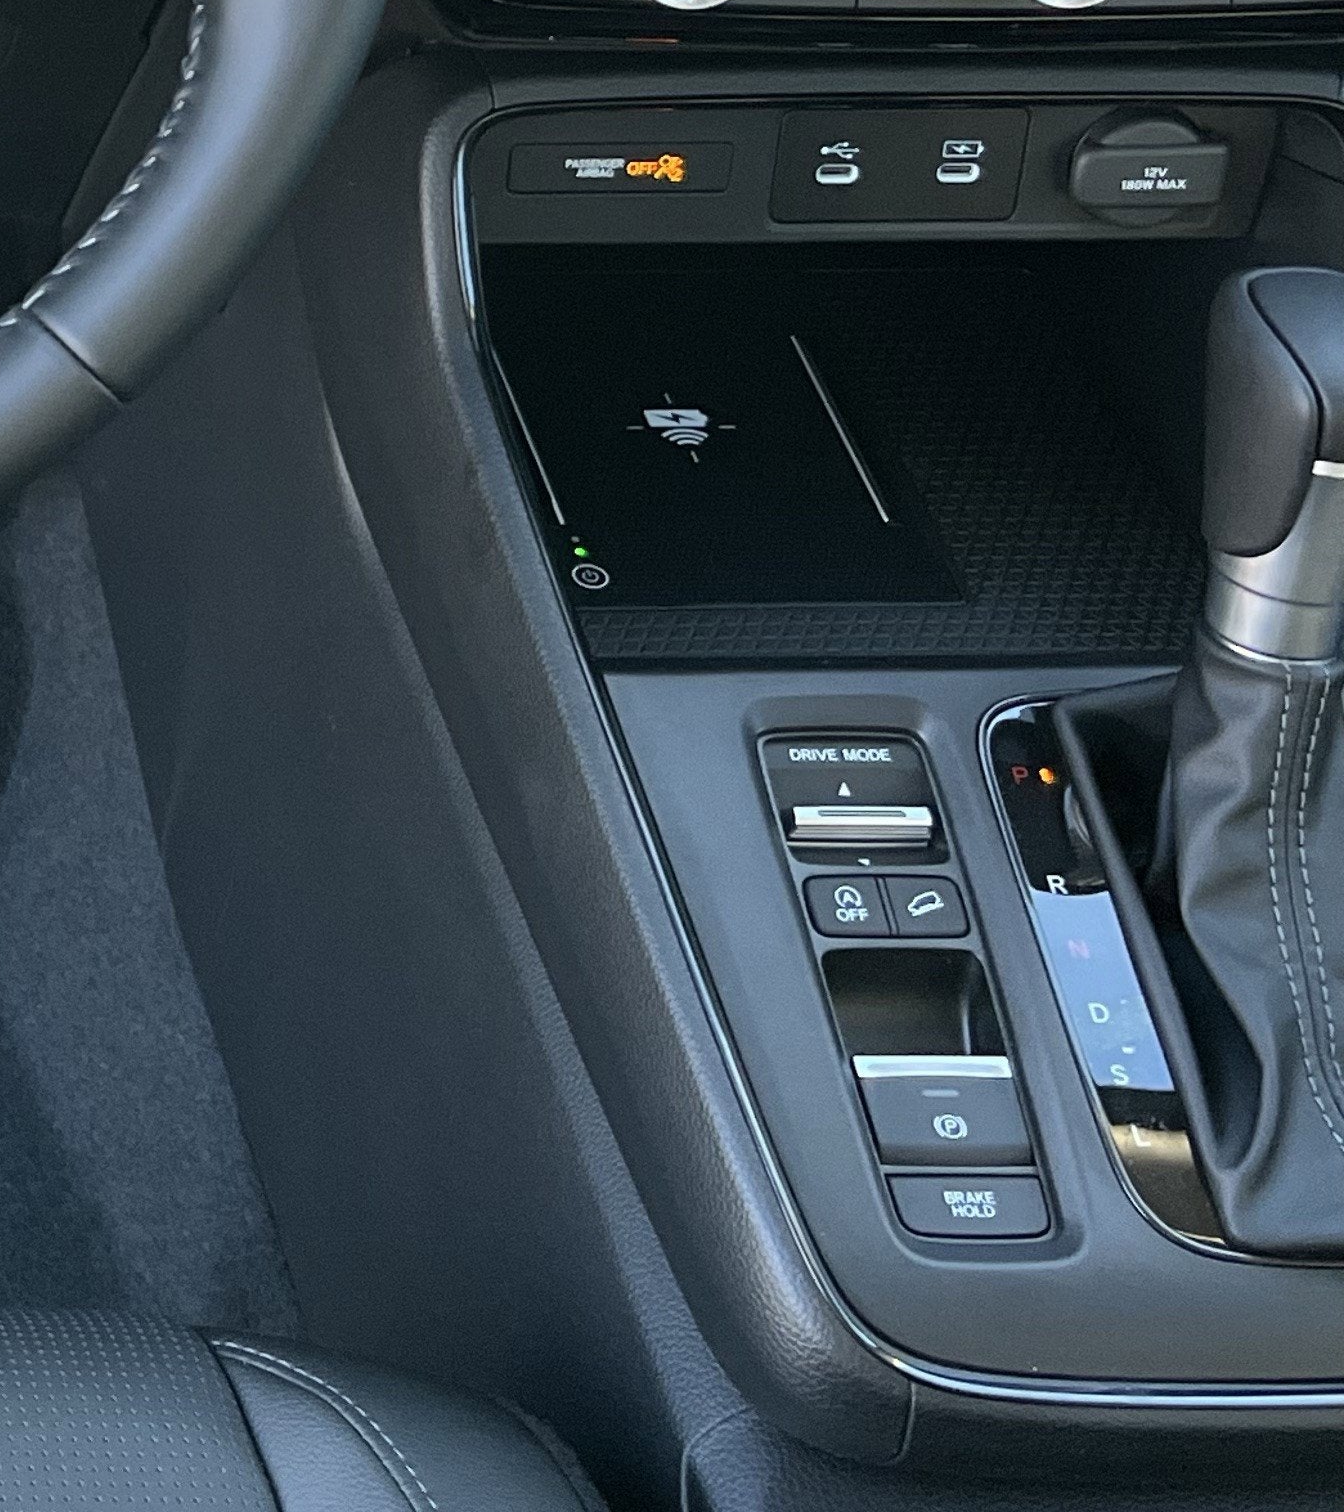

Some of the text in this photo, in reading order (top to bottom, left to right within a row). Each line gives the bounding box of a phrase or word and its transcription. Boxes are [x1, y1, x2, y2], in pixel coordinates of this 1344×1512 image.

[626, 161, 658, 176] OFF
[1144, 167, 1168, 178] 12V
[1155, 179, 1187, 189] MAX
[789, 748, 892, 762] DRIVE MODE
[1012, 765, 1029, 785] P
[1047, 874, 1068, 895] R
[835, 907, 870, 922] OFF
[1068, 940, 1091, 959] N
[1088, 1003, 1110, 1025] D
[1111, 1063, 1130, 1085] S
[1130, 1125, 1151, 1147] L
[943, 1191, 997, 1205] BRAKE
[951, 1204, 996, 1218] HOLD
